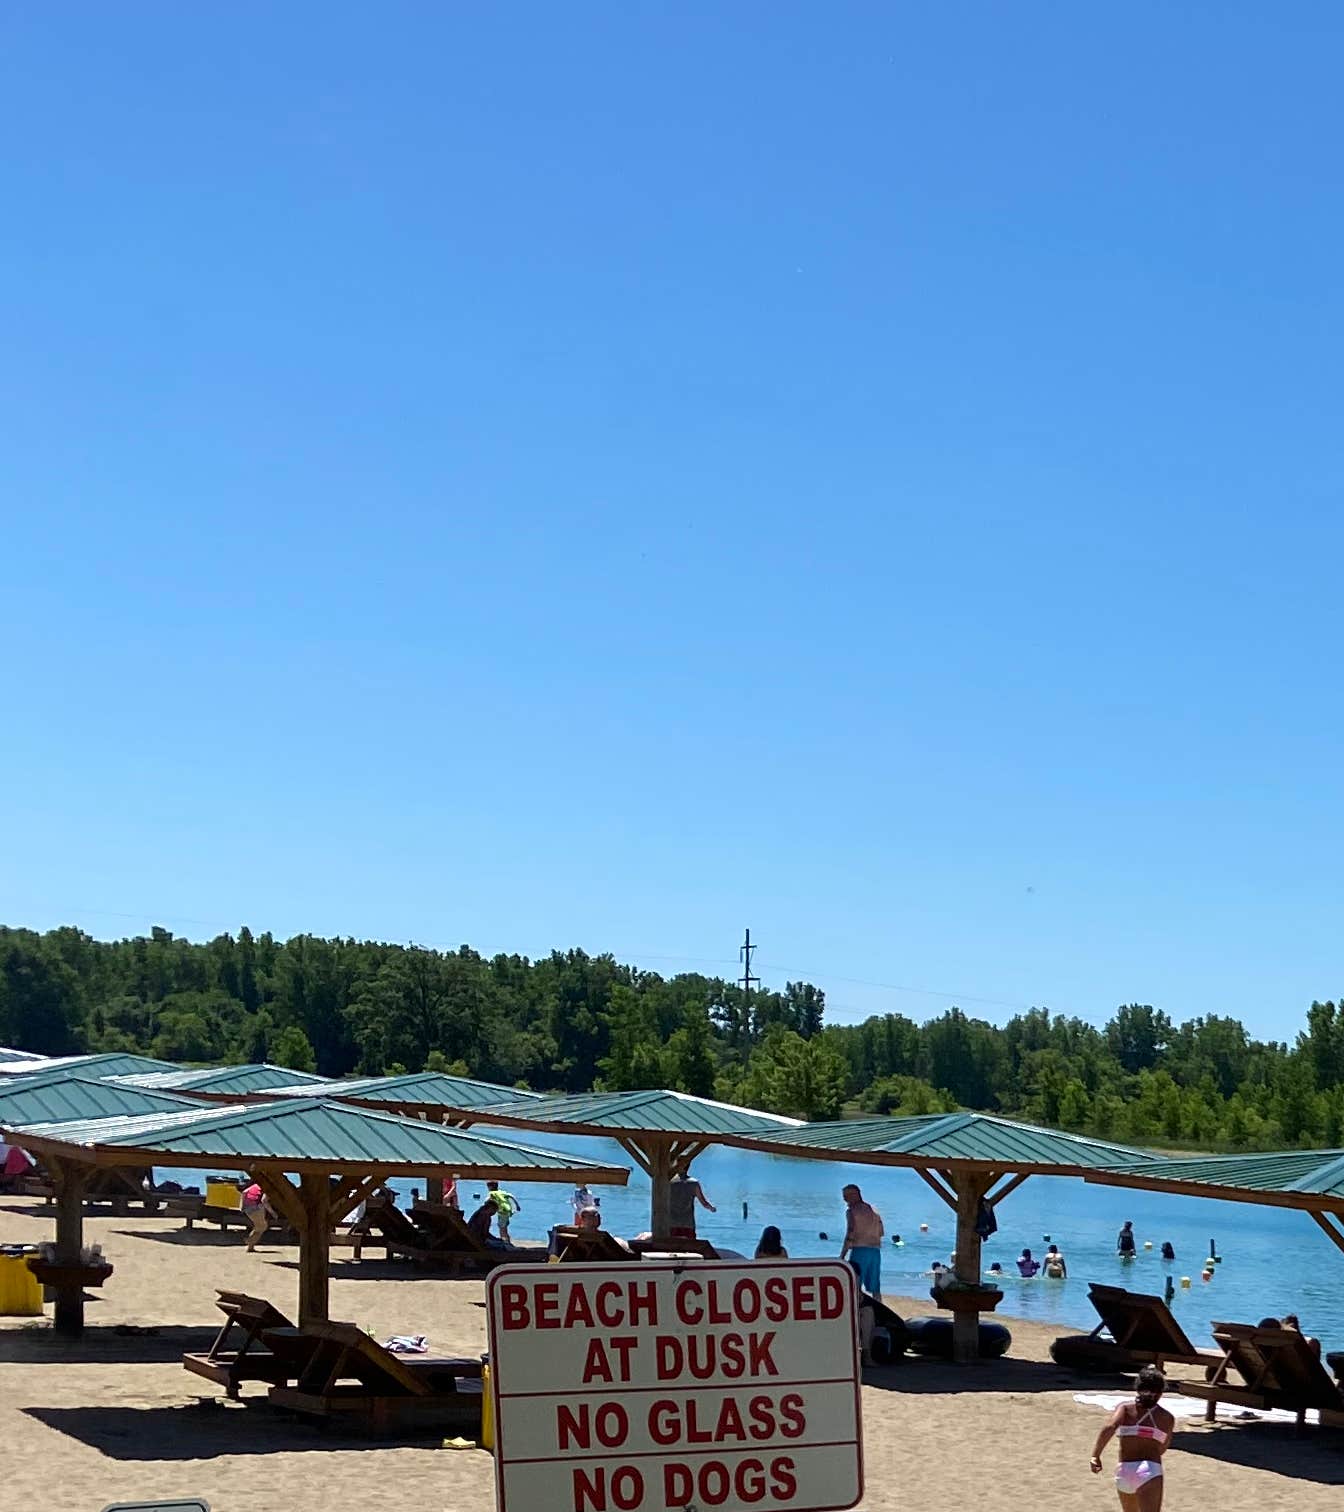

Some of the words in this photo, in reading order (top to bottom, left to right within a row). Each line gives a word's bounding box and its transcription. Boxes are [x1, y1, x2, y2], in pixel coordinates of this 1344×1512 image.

[502, 1280, 658, 1330] BEACH
[676, 1276, 844, 1327] CLOSED
[582, 1337, 638, 1384] AT
[657, 1332, 779, 1381] DUSK
[557, 1402, 629, 1450] NO
[648, 1394, 806, 1444] GLASS
[572, 1465, 644, 1512] NO
[664, 1457, 798, 1508] DOGS
